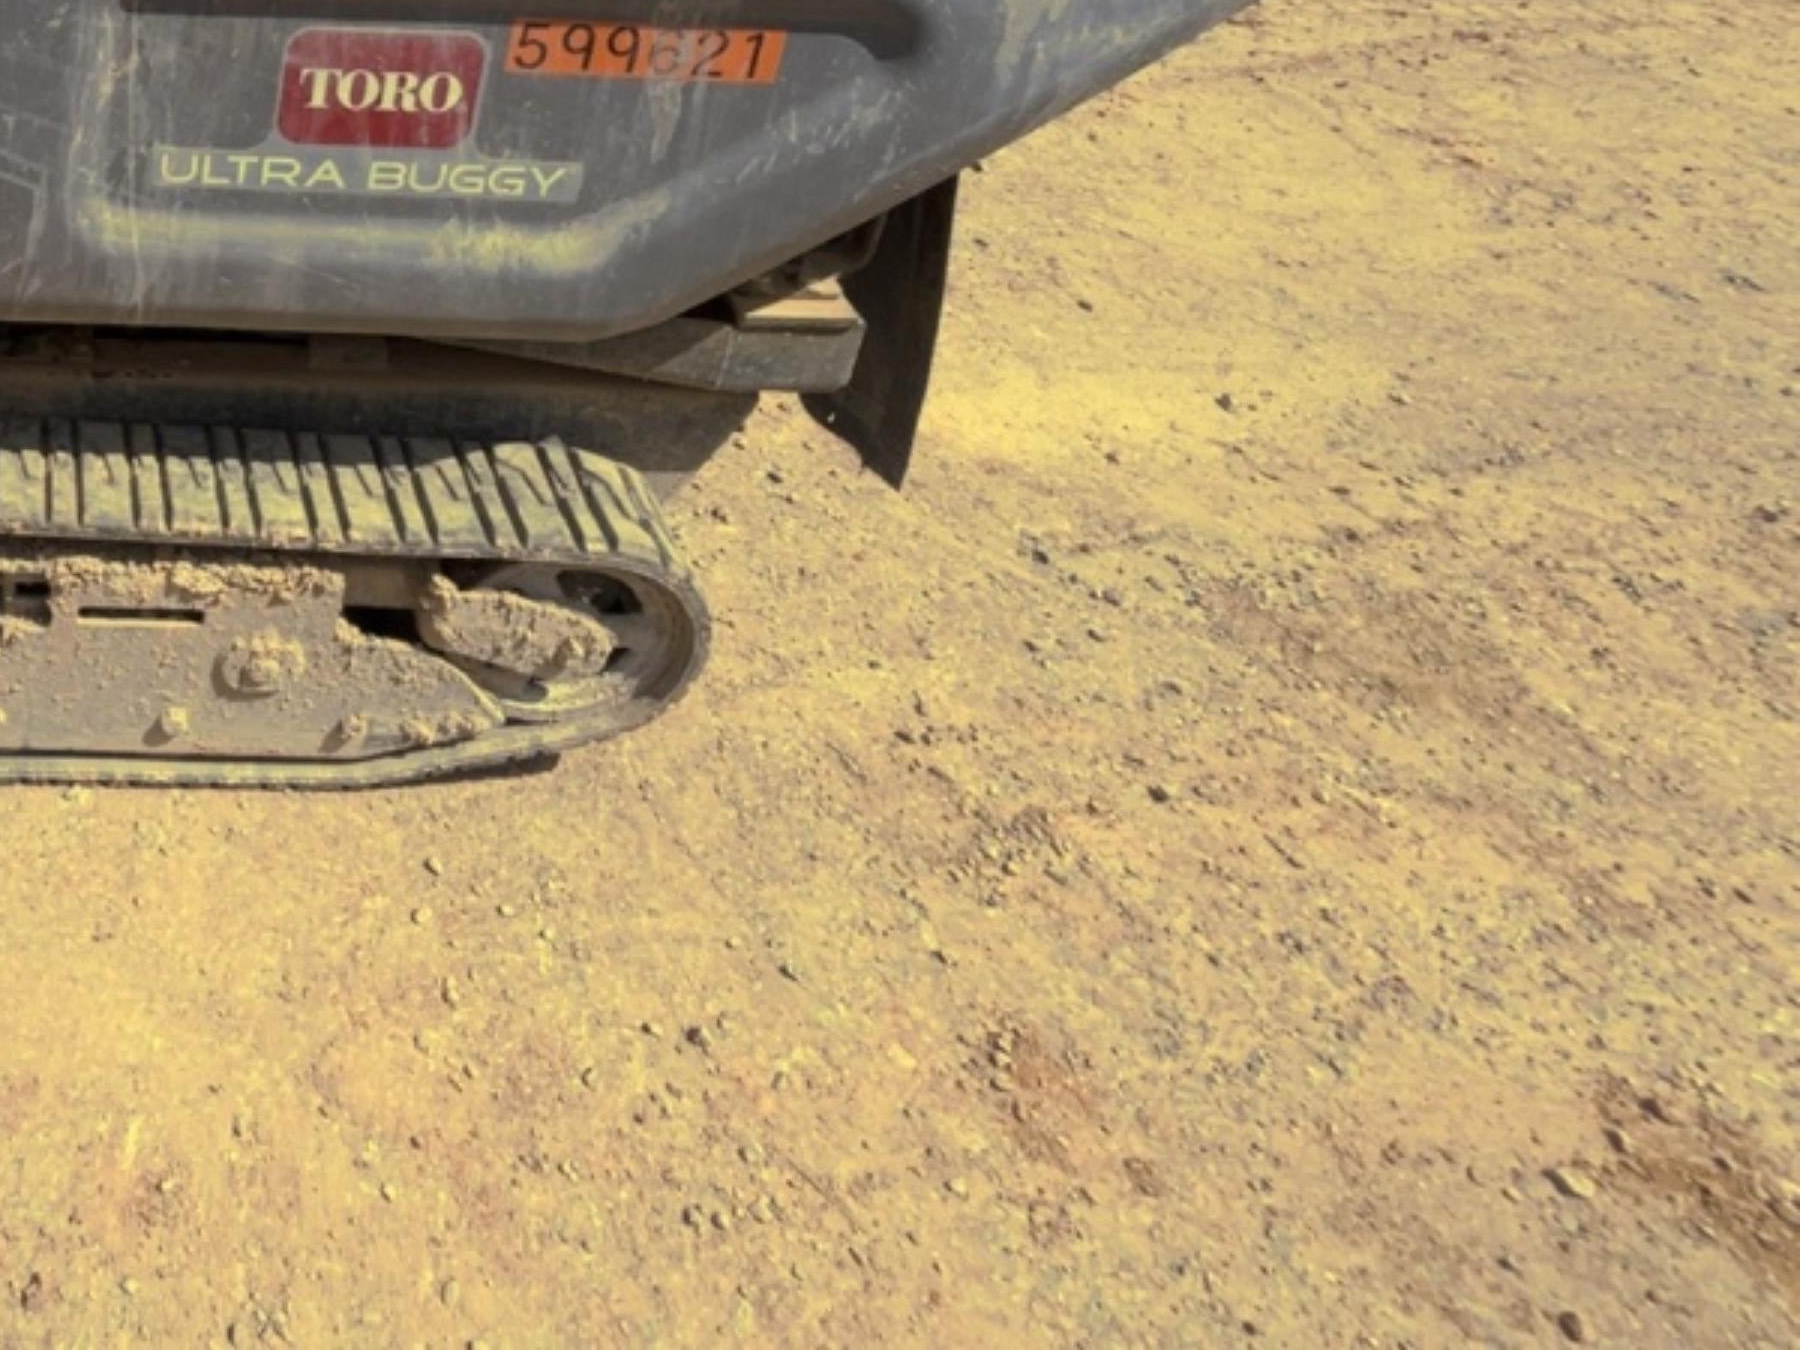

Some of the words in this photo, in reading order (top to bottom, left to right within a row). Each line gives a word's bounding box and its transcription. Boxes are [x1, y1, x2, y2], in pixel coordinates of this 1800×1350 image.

[513, 21, 765, 80] 599621
[299, 67, 464, 113] TORO
[160, 153, 345, 189] ULTRA
[367, 160, 570, 197] BUGGY
